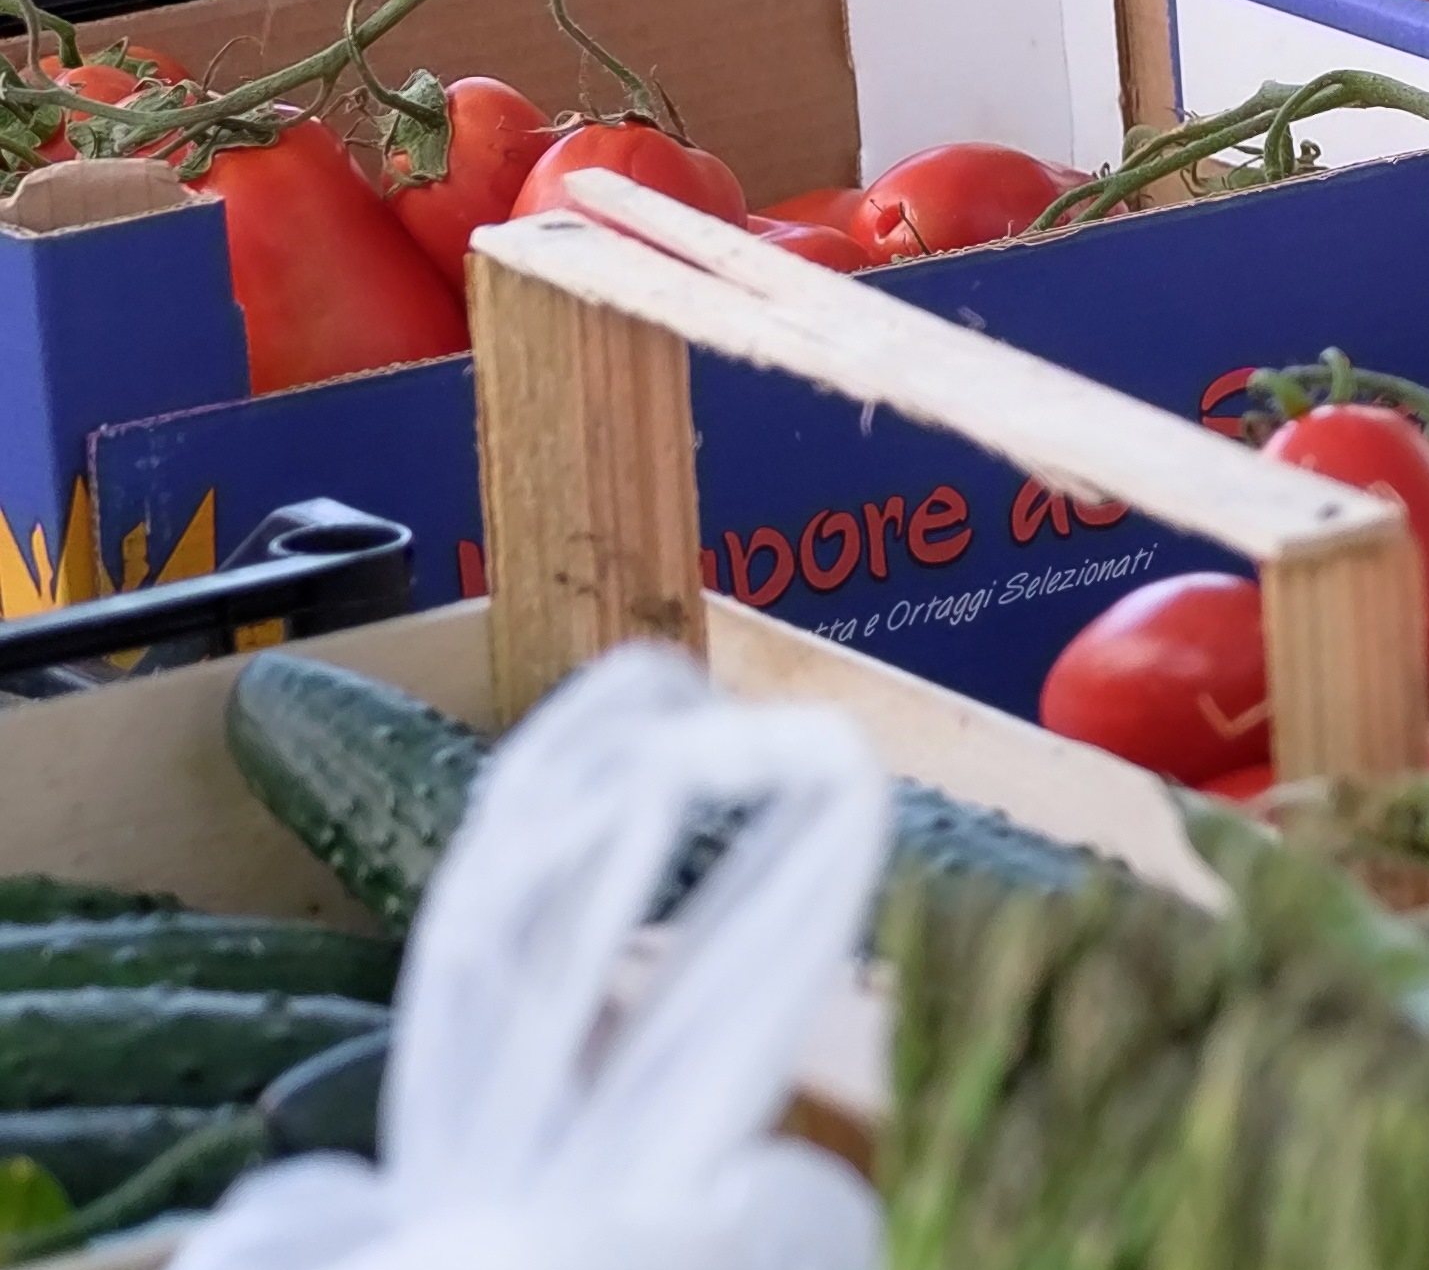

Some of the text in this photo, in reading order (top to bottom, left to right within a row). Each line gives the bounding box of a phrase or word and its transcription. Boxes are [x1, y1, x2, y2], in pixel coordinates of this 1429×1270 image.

[864, 612, 880, 637] e
[887, 580, 998, 626] Ortaggi
[998, 543, 1158, 605] Selezionati
